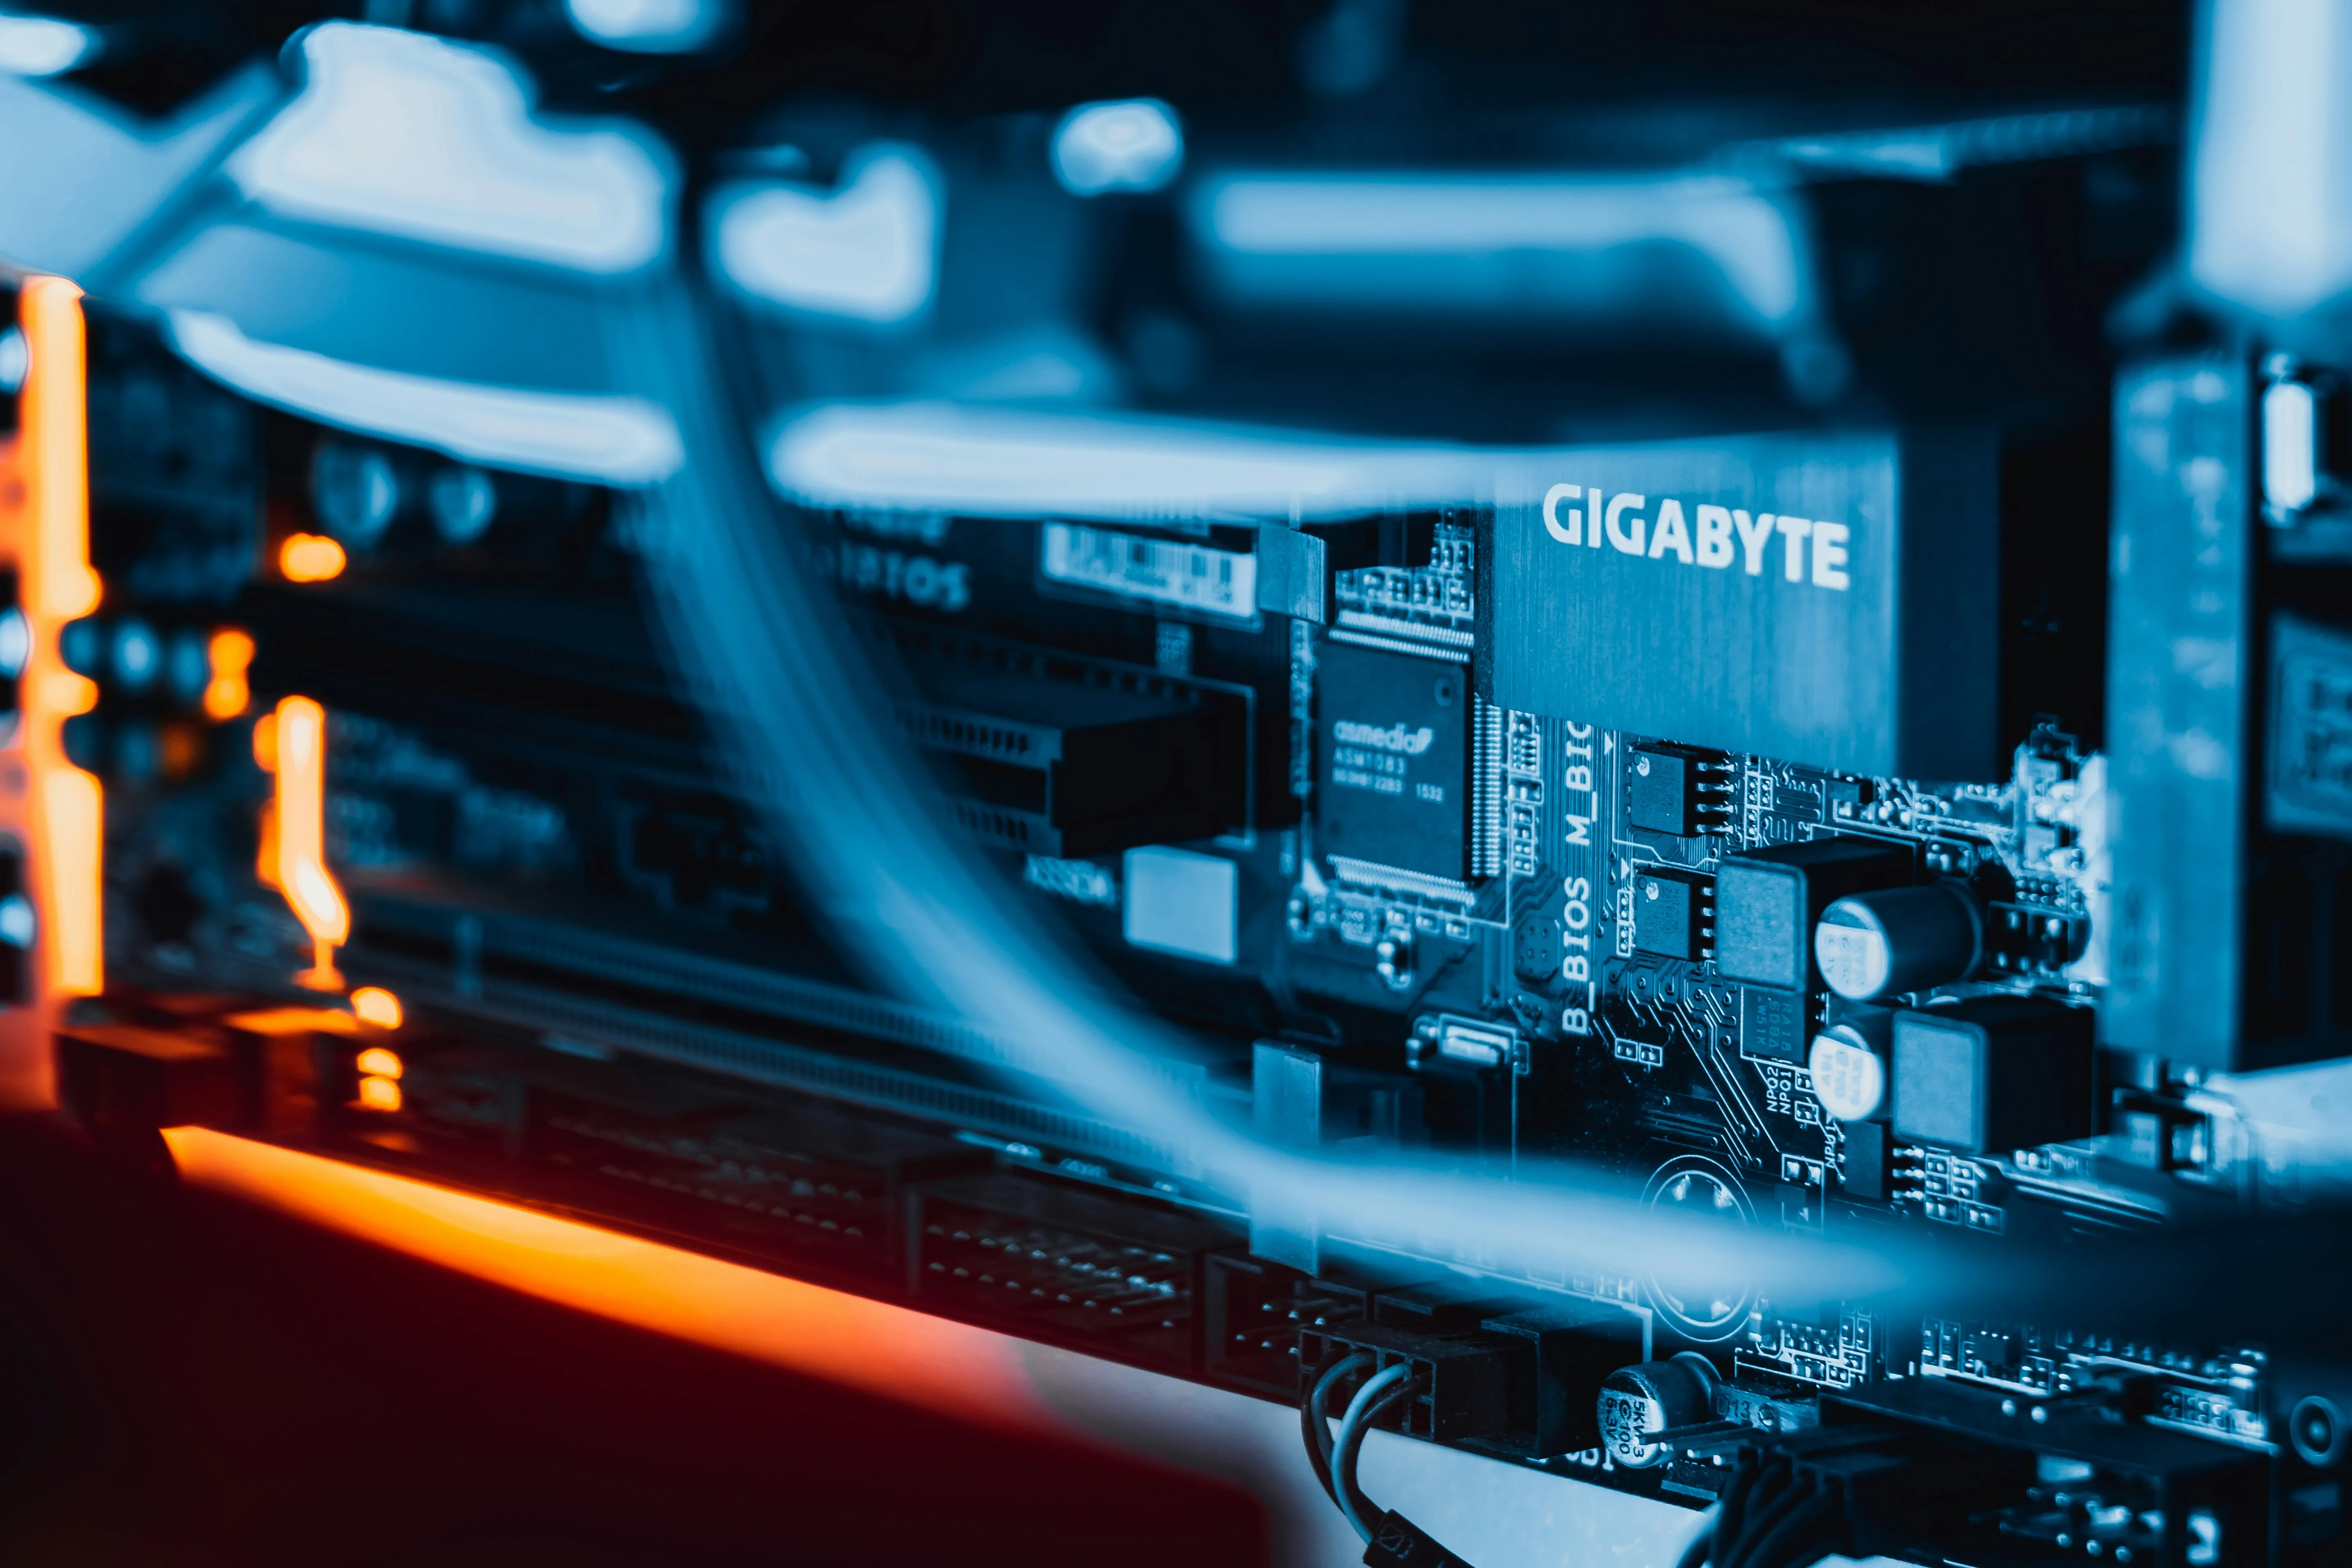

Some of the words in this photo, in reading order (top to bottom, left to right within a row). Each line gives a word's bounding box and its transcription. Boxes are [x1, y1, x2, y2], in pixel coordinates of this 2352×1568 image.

[1543, 483, 1850, 591] GIGABYTE
[1562, 876, 1595, 1035] B_BIOS
[1781, 1003, 1792, 1051] RA18
[1605, 1397, 1617, 1440] 6.3V
